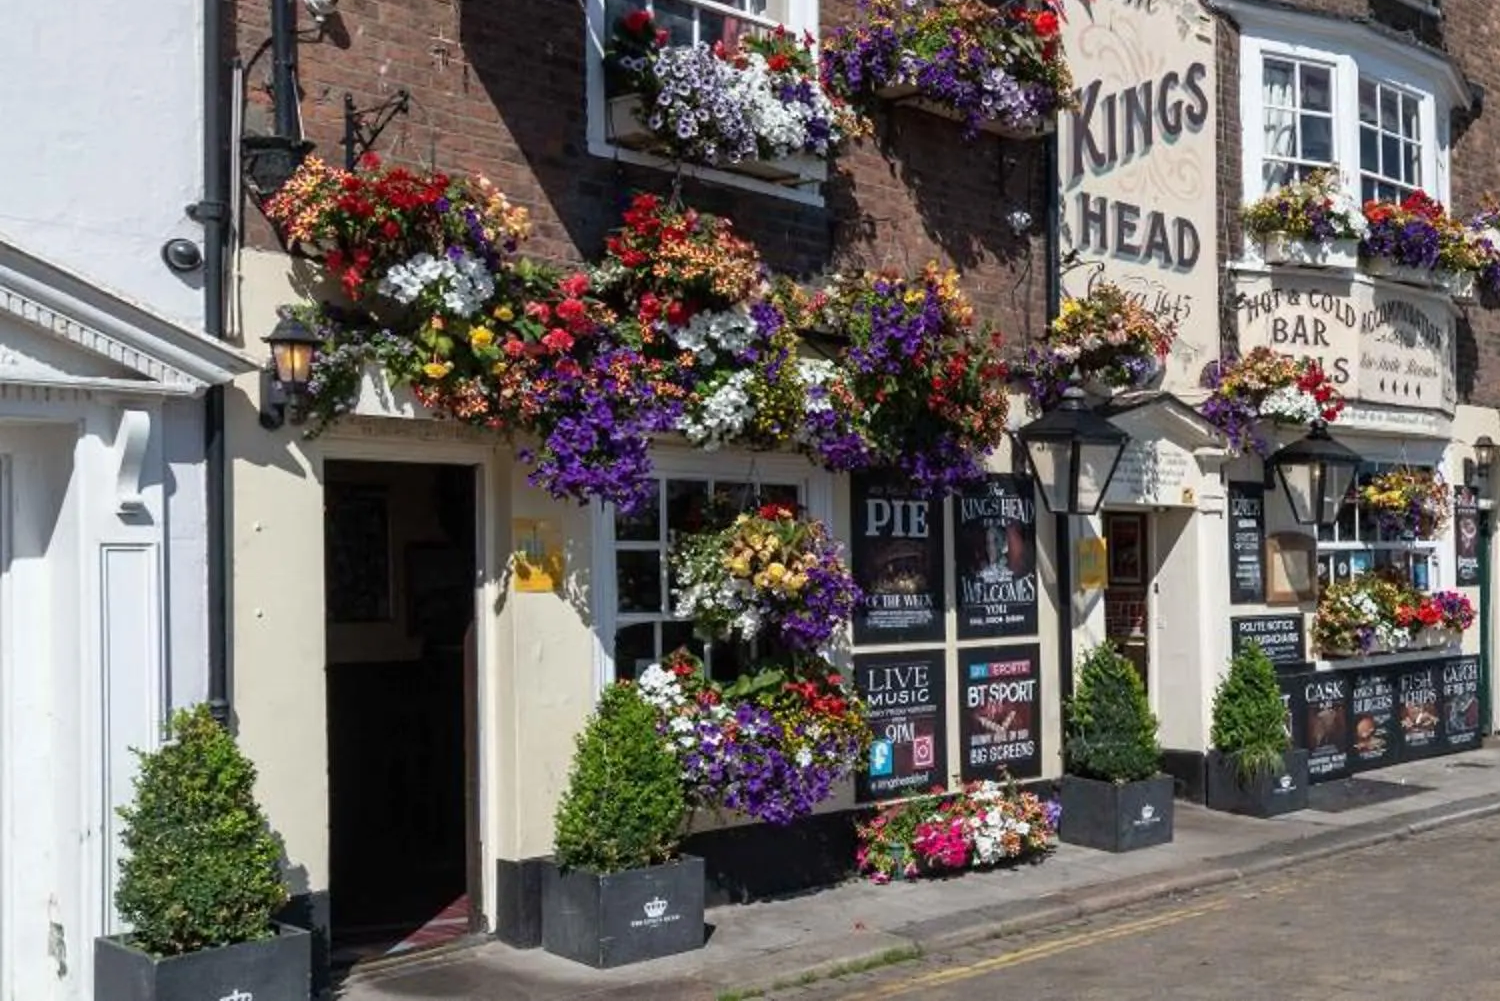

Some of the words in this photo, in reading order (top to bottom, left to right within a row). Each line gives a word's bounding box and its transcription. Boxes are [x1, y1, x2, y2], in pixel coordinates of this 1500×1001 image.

[1068, 62, 1208, 187] KINGS
[1076, 191, 1200, 274] HEAD
[1247, 288, 1280, 323] HOT
[1288, 289, 1301, 306] &
[1309, 289, 1357, 328] COLD
[1273, 315, 1330, 347] BAR
[865, 499, 929, 538] PIE
[1001, 498, 1035, 524] HEAD
[962, 574, 1036, 605] WELCOMES
[868, 666, 930, 692] LIVE
[1305, 680, 1344, 703] CASK
[867, 689, 930, 707] MUSIC
[967, 684, 988, 708] BT
[989, 680, 1036, 702] SPORT
[990, 740, 1036, 763] SCREENS
